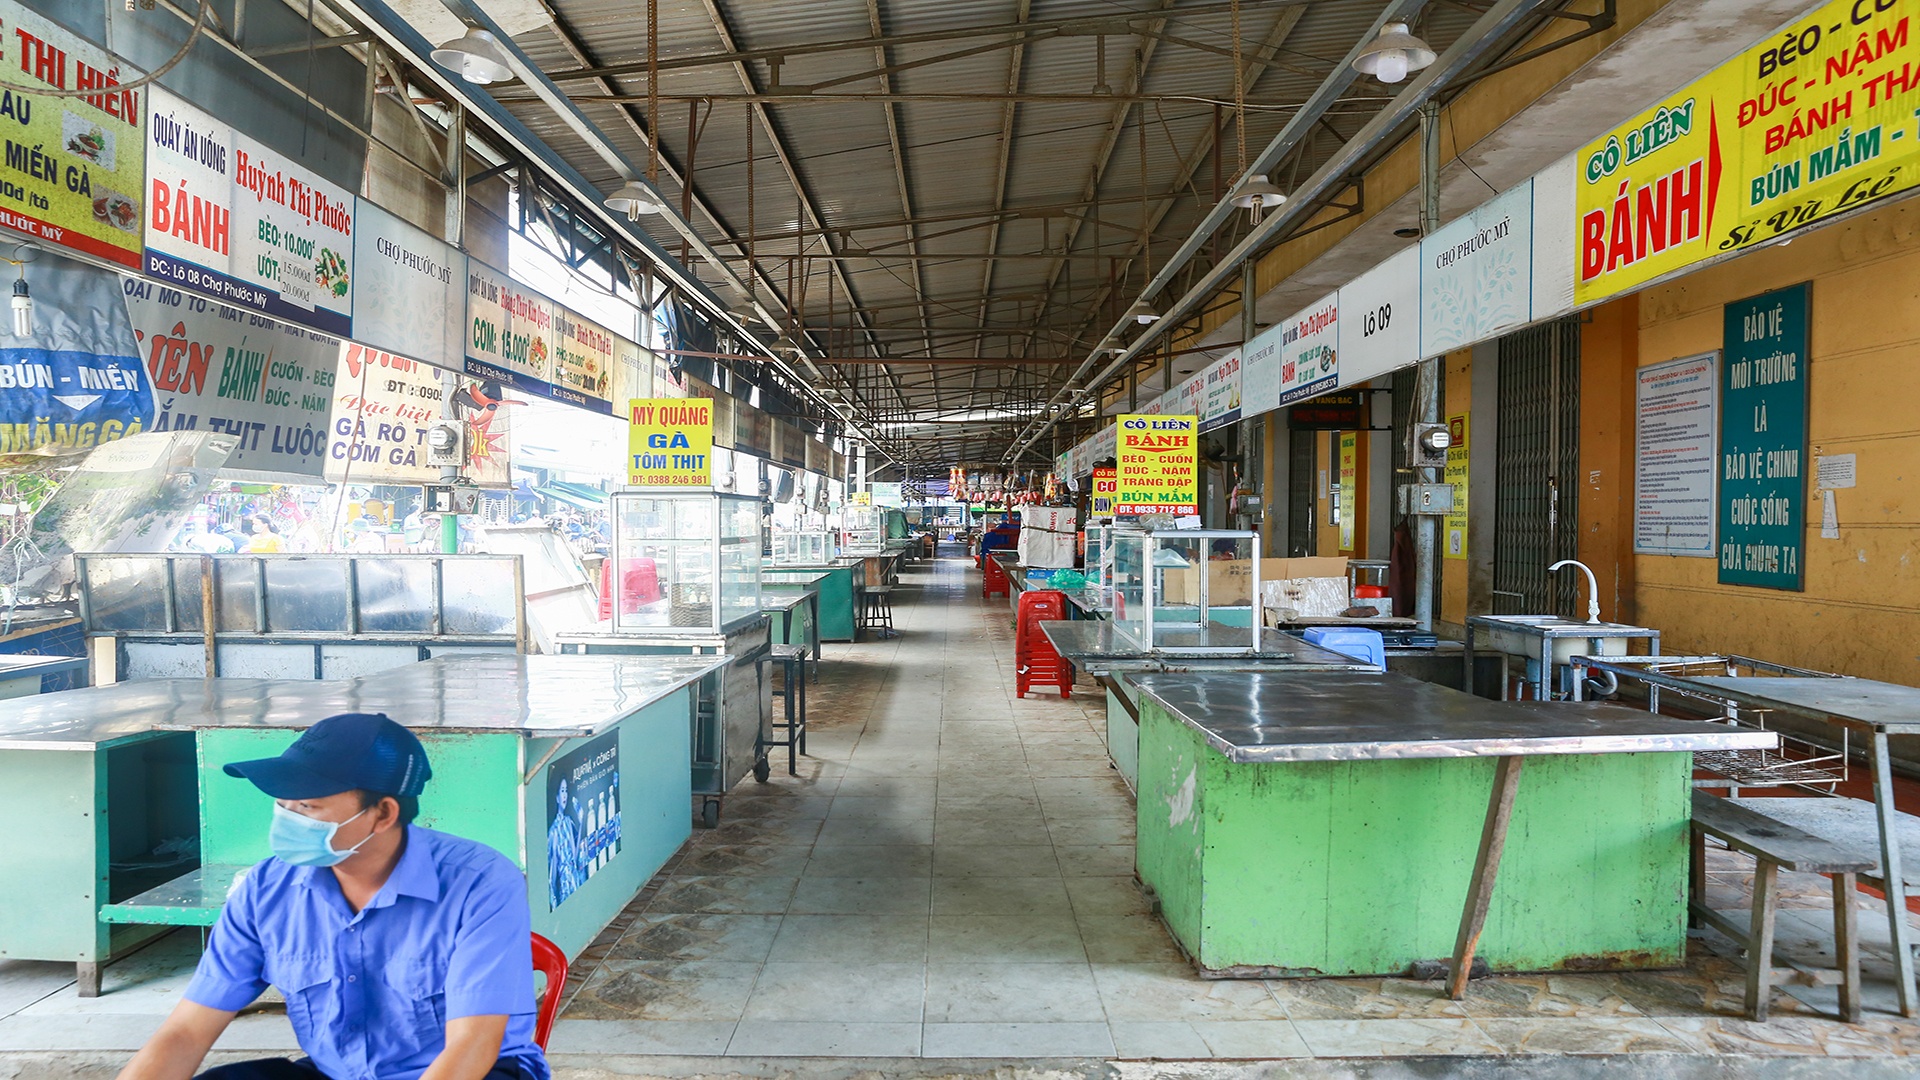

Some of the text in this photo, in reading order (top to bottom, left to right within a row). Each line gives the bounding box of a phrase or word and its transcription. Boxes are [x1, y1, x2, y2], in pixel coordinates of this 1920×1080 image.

[1737, 15, 1909, 129] ĐÚC NẬM
[1759, 25, 1821, 80] BÈO
[1586, 97, 1696, 185] CÔ LIÊN
[1765, 90, 1852, 156] BÁNH
[154, 111, 226, 175] QUẦY ĂN UỐNG
[6, 139, 92, 198] MIẾN GÀ
[1750, 126, 1882, 207] BÚN MẮM
[236, 149, 351, 236] Huỳnh Thị Phước
[152, 178, 230, 256] BÁNH
[258, 214, 281, 248] BÈO:
[1581, 159, 1704, 282] BÁNH
[377, 236, 452, 285] CHỢ PHƯỚC MỸ
[1436, 215, 1511, 270] CHỢ PHƯỚC MỸ
[150, 257, 268, 309] ĐC: Lô 08 Chợ Phước Mỹ
[1378, 302, 1392, 332] 09
[1744, 303, 1783, 342] BẢO VỆ
[78, 363, 140, 392] MIẾN
[217, 335, 265, 402] BÁNH
[270, 360, 304, 382] CUỐN
[313, 368, 336, 388] BÈO
[1731, 358, 1751, 390] MÔI
[1755, 350, 1796, 385] TRƯỜNG
[265, 387, 327, 415] ĐÚC NẬM
[632, 401, 708, 427] MỲ QUẢNG
[1754, 399, 1767, 433] LÀ
[271, 422, 328, 464] LUỘC
[336, 415, 367, 438] GÀ
[648, 430, 690, 449] GÀ
[1124, 418, 1147, 430] CÔ
[1151, 419, 1192, 431] LIÊN
[1125, 432, 1190, 447] BÁNH
[331, 440, 417, 467] CƠM GÀ
[633, 451, 706, 473] TÔM THỊT
[1122, 453, 1193, 464] BÈO CUỐN
[1124, 465, 1191, 477] ĐÚC NẬM
[1726, 446, 1746, 480] BẢO
[1749, 447, 1763, 485] VỆ
[1766, 445, 1798, 479] CHÍNH
[632, 475, 707, 484] ĐT: 0388 246 981
[1121, 488, 1194, 502] BÚN MẮM
[1122, 477, 1193, 489] TRÁNG ĐẬP
[1134, 505, 1157, 514] 0935
[1159, 506, 1175, 514] 712
[1731, 490, 1789, 531] CUỘC SỐNG
[1722, 536, 1797, 575] CỦA CHÚNG TA
